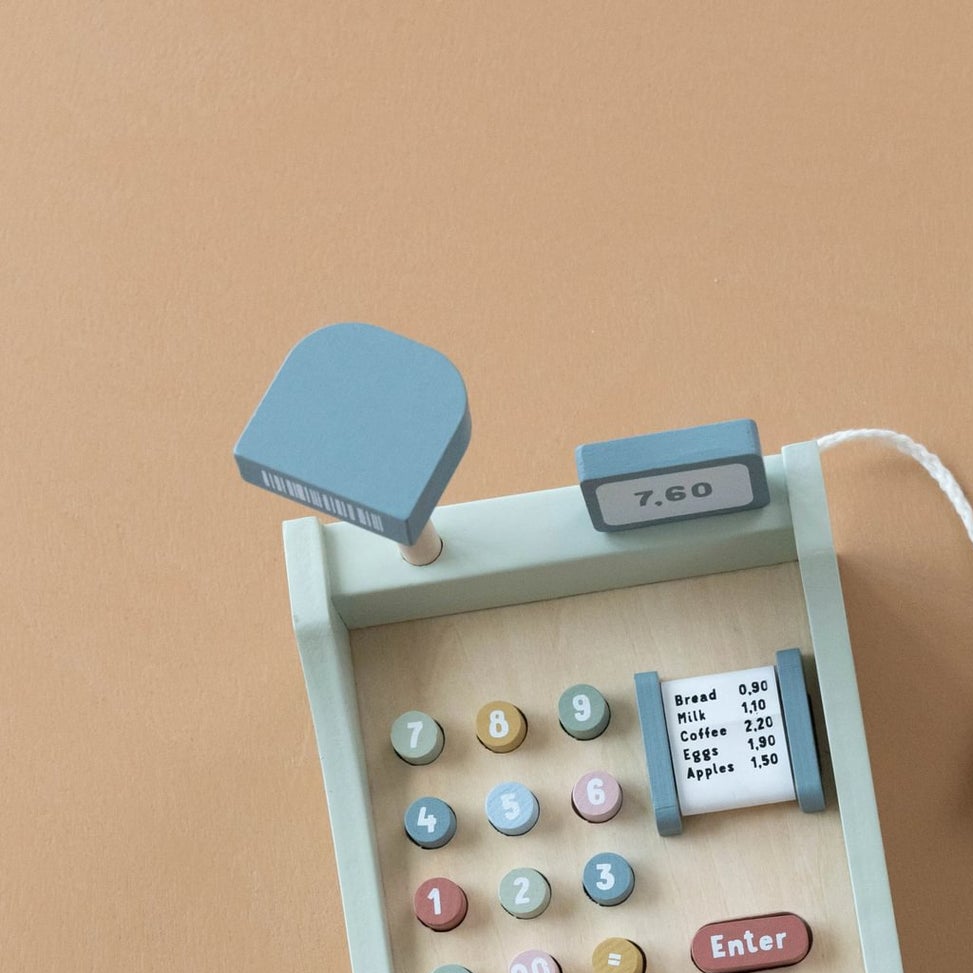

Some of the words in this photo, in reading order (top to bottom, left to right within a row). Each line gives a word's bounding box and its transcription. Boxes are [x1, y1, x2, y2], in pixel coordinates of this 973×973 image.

[572, 694, 591, 722] 9
[674, 688, 717, 706] Bread
[489, 710, 509, 738] 8
[676, 709, 706, 724] Milk
[407, 721, 424, 749] 7
[680, 727, 727, 742] Coffee
[684, 748, 719, 763] Eggs
[687, 763, 735, 781] Apples
[586, 778, 605, 805] 6
[417, 806, 437, 833] 4
[501, 793, 520, 821] 5
[513, 877, 530, 905] 2
[596, 863, 615, 891] 3
[427, 887, 442, 915] 1
[710, 930, 787, 959] Enter
